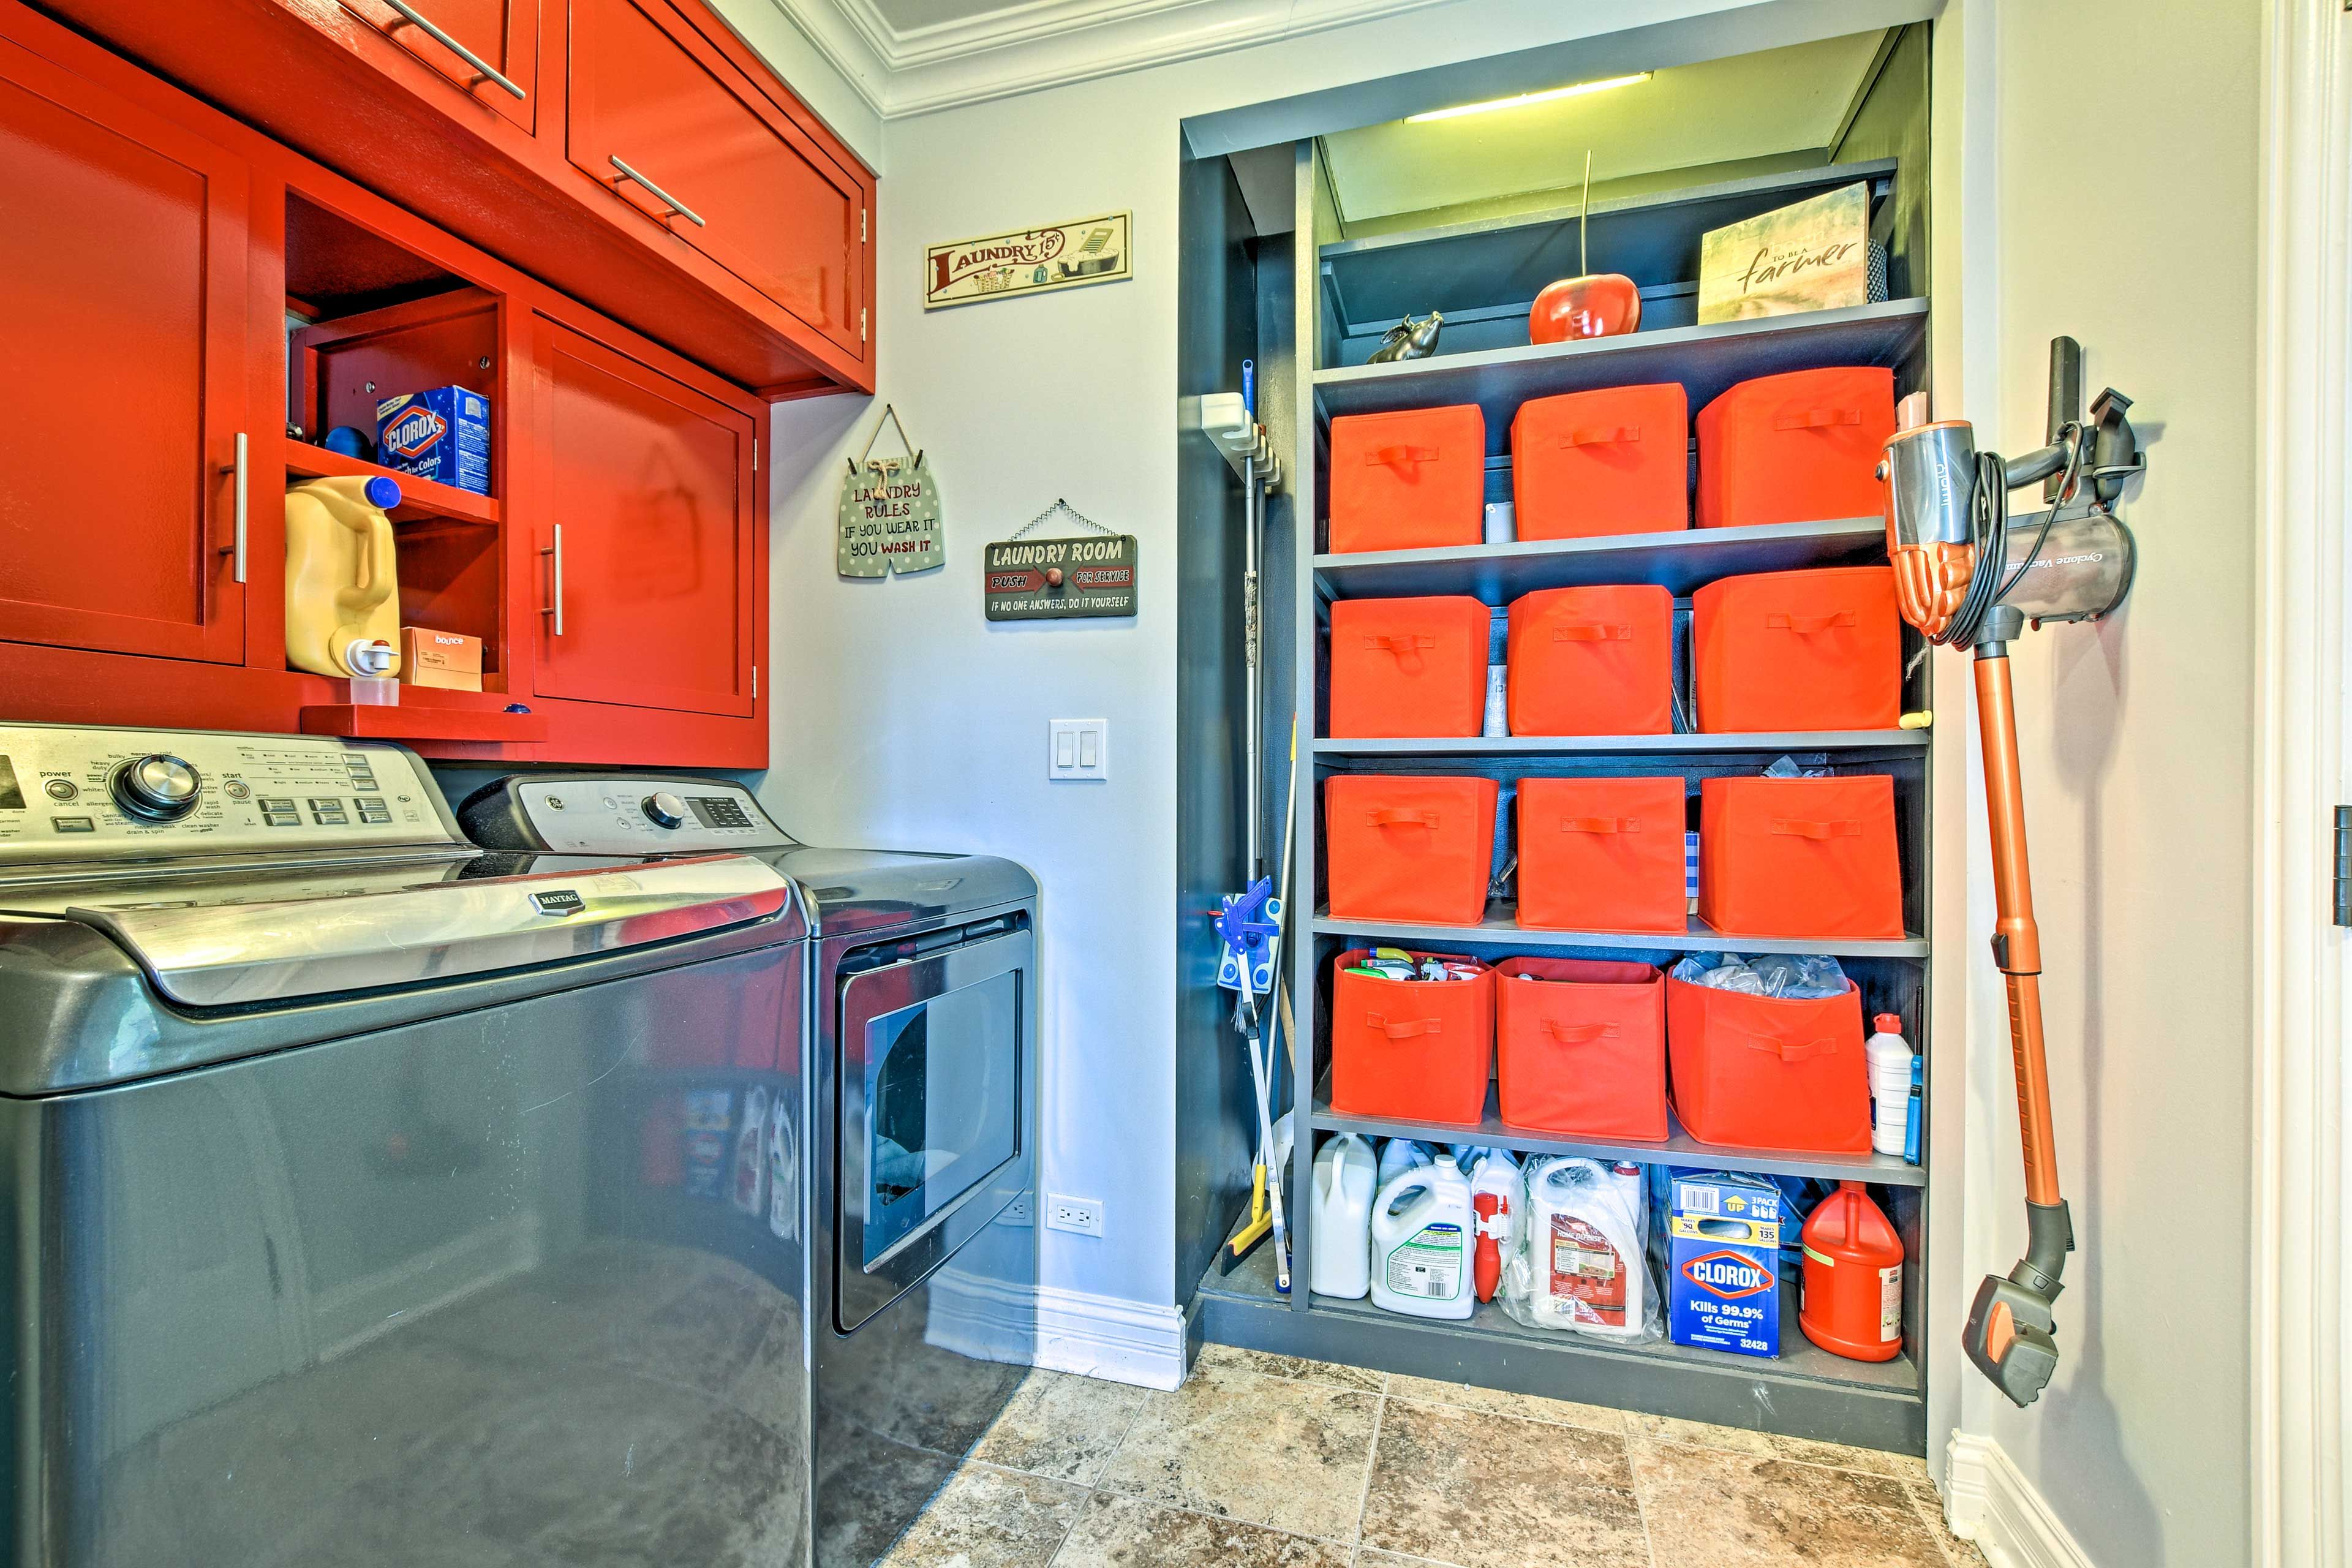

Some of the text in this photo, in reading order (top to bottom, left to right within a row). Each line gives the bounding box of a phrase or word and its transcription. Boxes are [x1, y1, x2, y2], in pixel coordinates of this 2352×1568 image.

[927, 244, 1038, 295] LAUNDRY
[1737, 243, 1858, 295] farmer
[388, 411, 437, 452] CLOROX
[418, 456, 442, 471] Colors
[865, 503, 910, 519] RULES
[845, 518, 936, 538] IF YOU WEAR IT
[851, 540, 931, 557] YOU WASH IT
[992, 540, 1123, 567] LAUNDRY ROOM
[2006, 552, 2103, 570] Cyclone Vacum
[991, 575, 1028, 588] PUSH
[1076, 570, 1129, 583] FOR SERVICE
[991, 596, 1129, 611] IF NO ONE ANSWERS, DO IT YOURSELF
[435, 635, 464, 645] bounce
[540, 894, 578, 904] MAYTAG
[1727, 1202, 1745, 1212] UP
[1759, 1230, 1774, 1239] 135
[1694, 1261, 1761, 1288] CLOROX
[1690, 1300, 1764, 1320] Kills 99.9%
[1702, 1315, 1713, 1324] of
[1740, 1338, 1768, 1351] 32428
